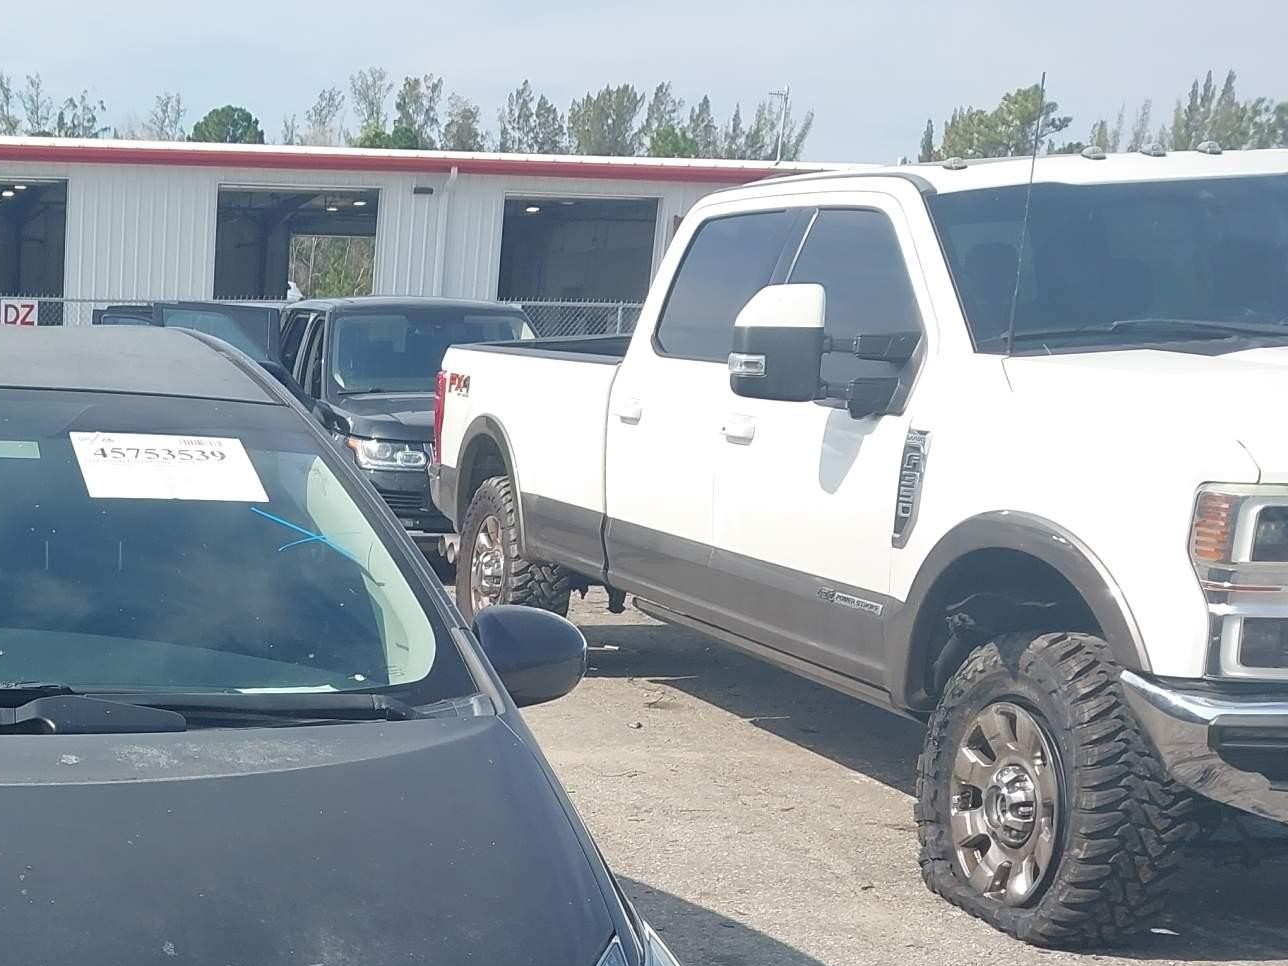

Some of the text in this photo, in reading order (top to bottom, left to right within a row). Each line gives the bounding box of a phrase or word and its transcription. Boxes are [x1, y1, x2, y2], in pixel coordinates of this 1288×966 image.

[4, 303, 35, 326] DZ
[448, 372, 471, 393] FX4
[93, 447, 227, 463] 45753539
